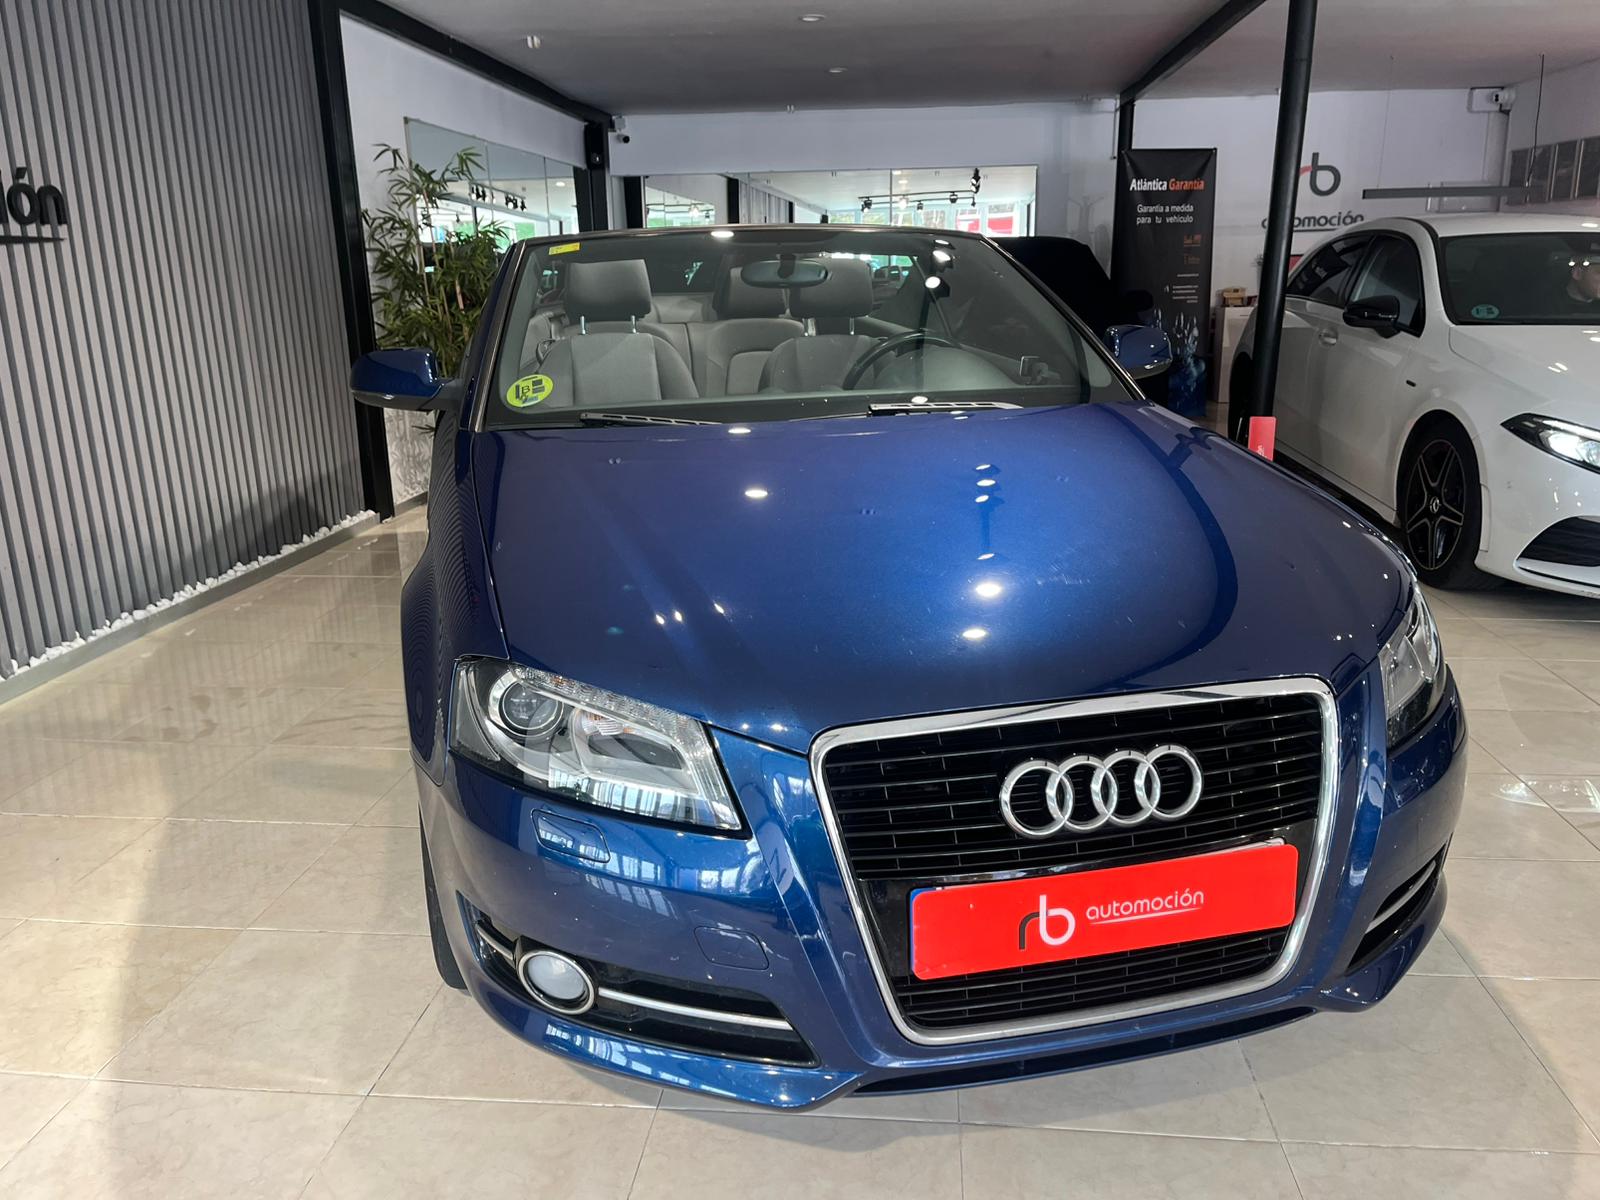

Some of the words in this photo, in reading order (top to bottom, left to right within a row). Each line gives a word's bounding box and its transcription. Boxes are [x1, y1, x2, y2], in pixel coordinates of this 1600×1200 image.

[1299, 152, 1341, 197] b
[1129, 178, 1167, 191] Atlántica
[1171, 204, 1194, 212] medida
[1137, 216, 1152, 225] para
[1018, 894, 1076, 950] rb
[1086, 888, 1205, 920] automoción
